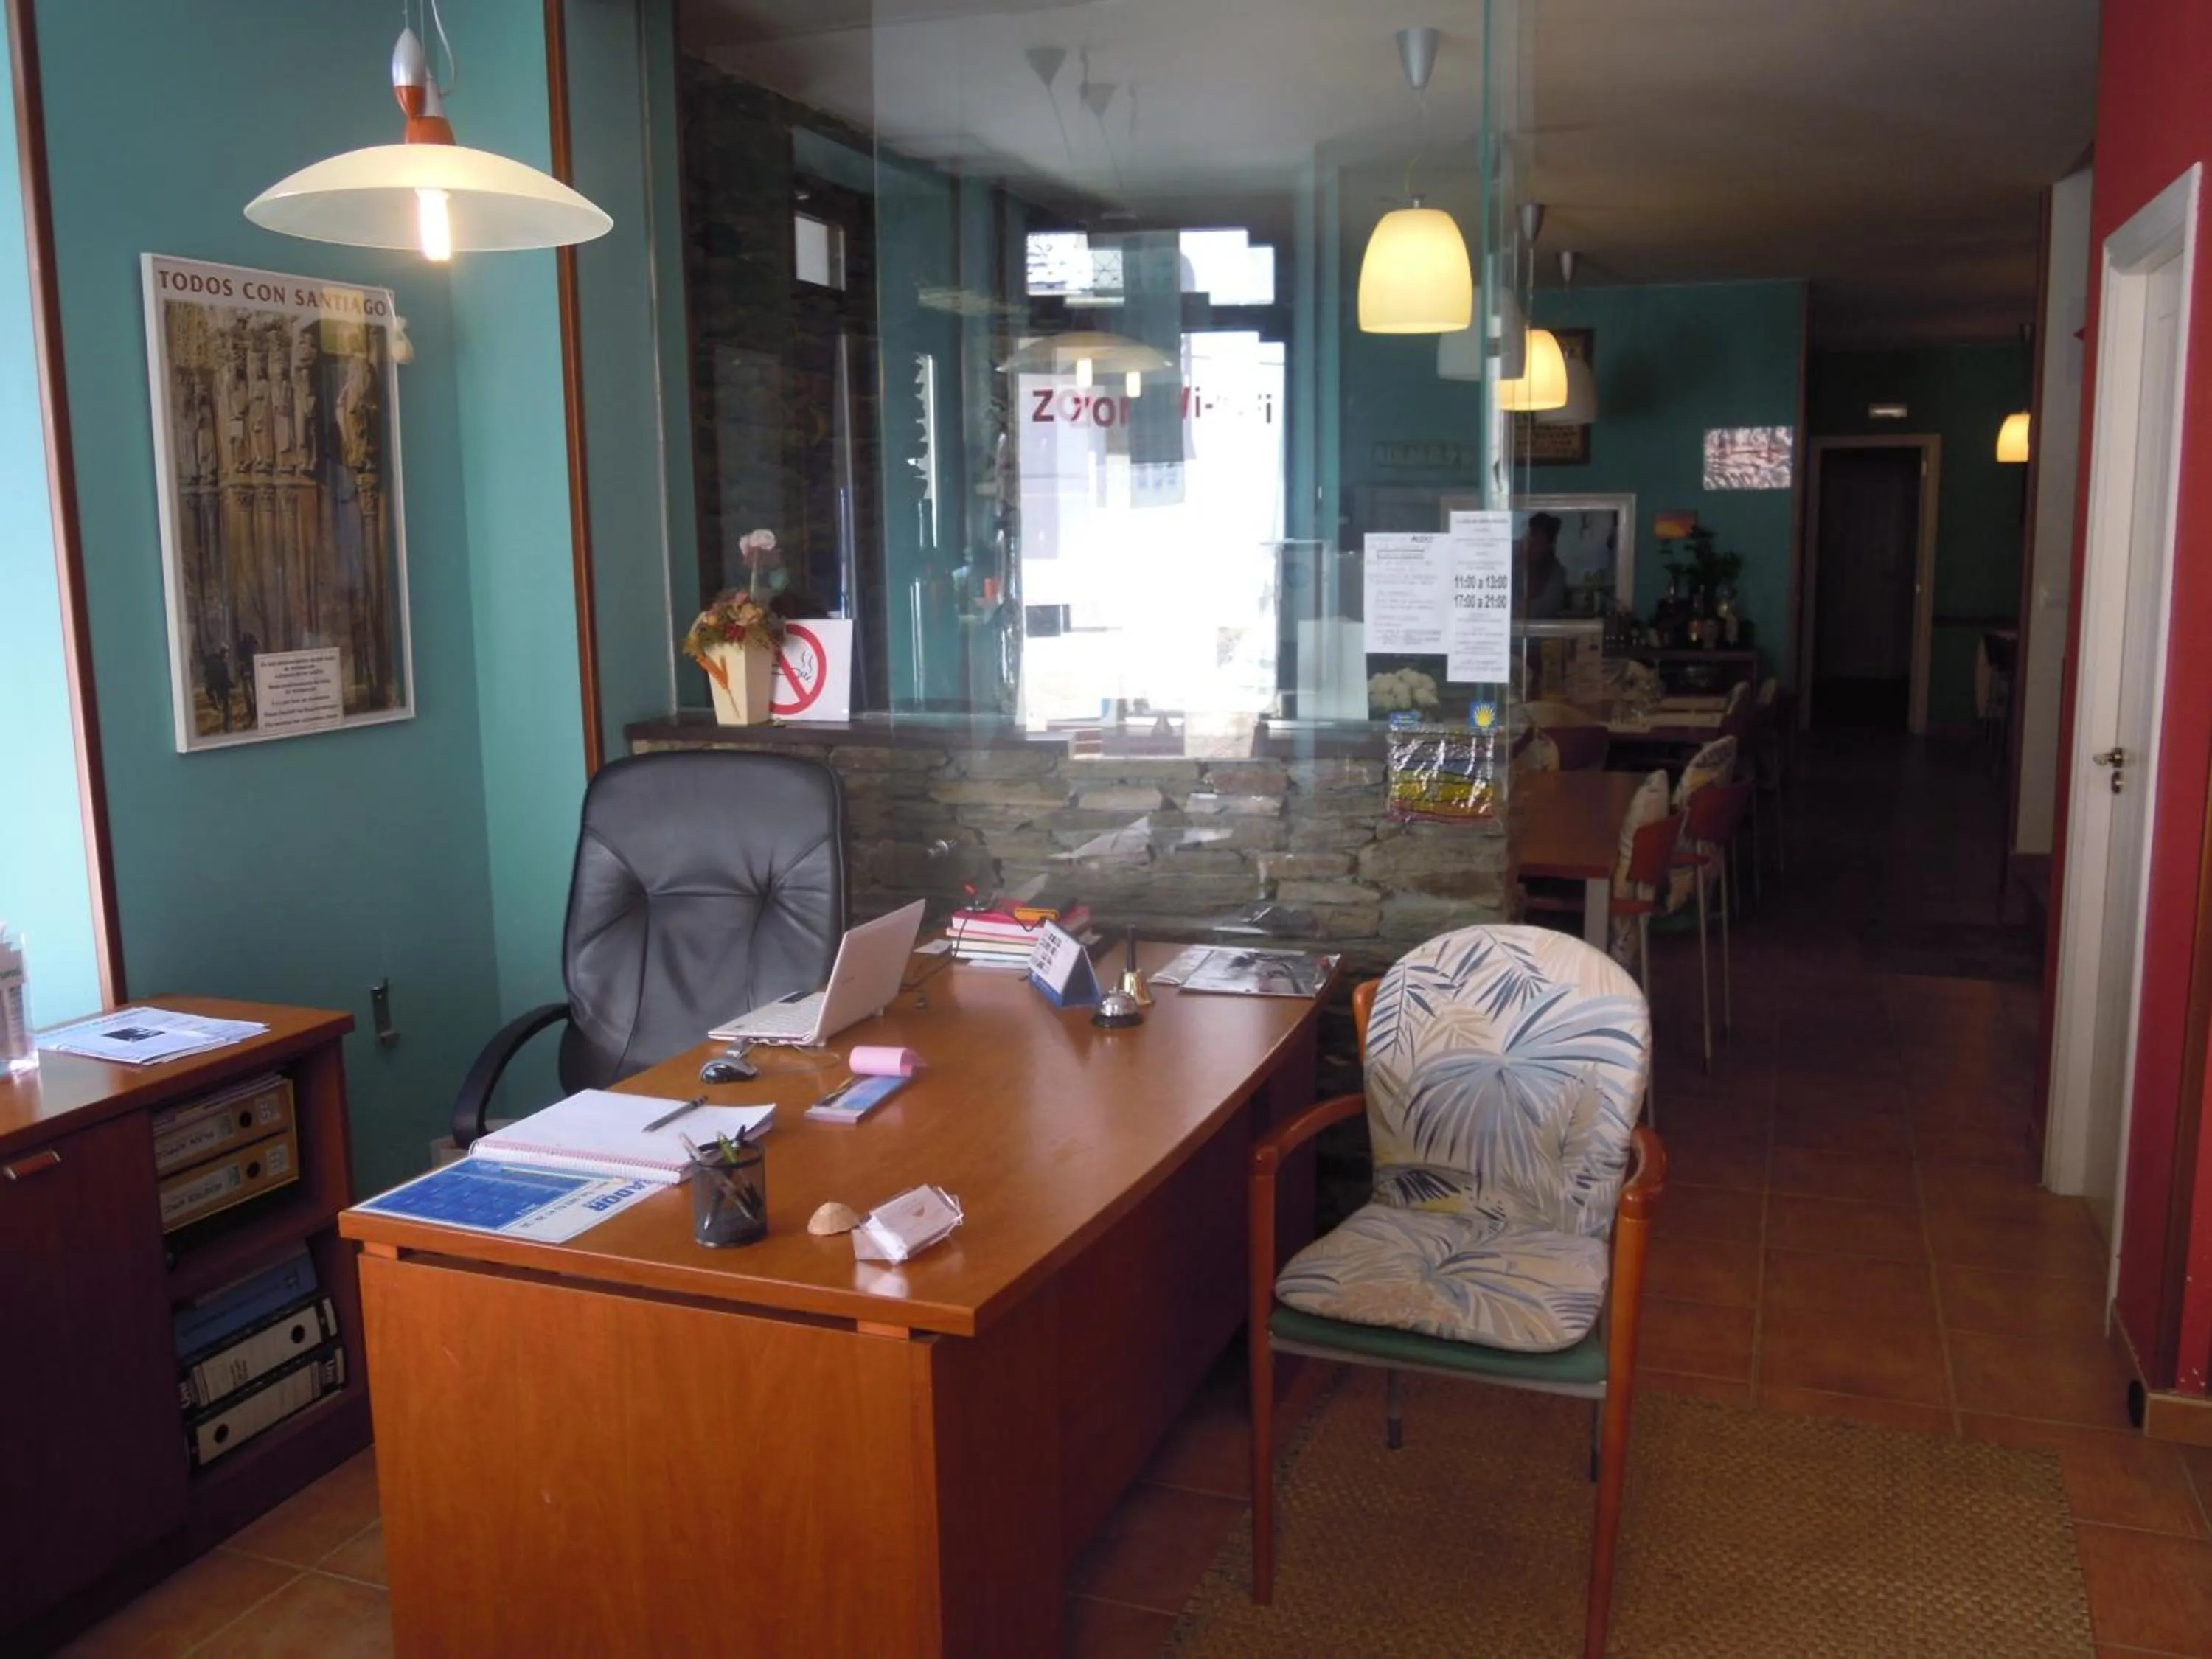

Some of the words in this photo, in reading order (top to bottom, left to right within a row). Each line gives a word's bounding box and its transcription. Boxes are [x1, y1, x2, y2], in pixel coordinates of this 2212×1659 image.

[159, 270, 233, 296] TODOS
[243, 282, 285, 305] CON
[295, 288, 386, 317] SANTIAGO
